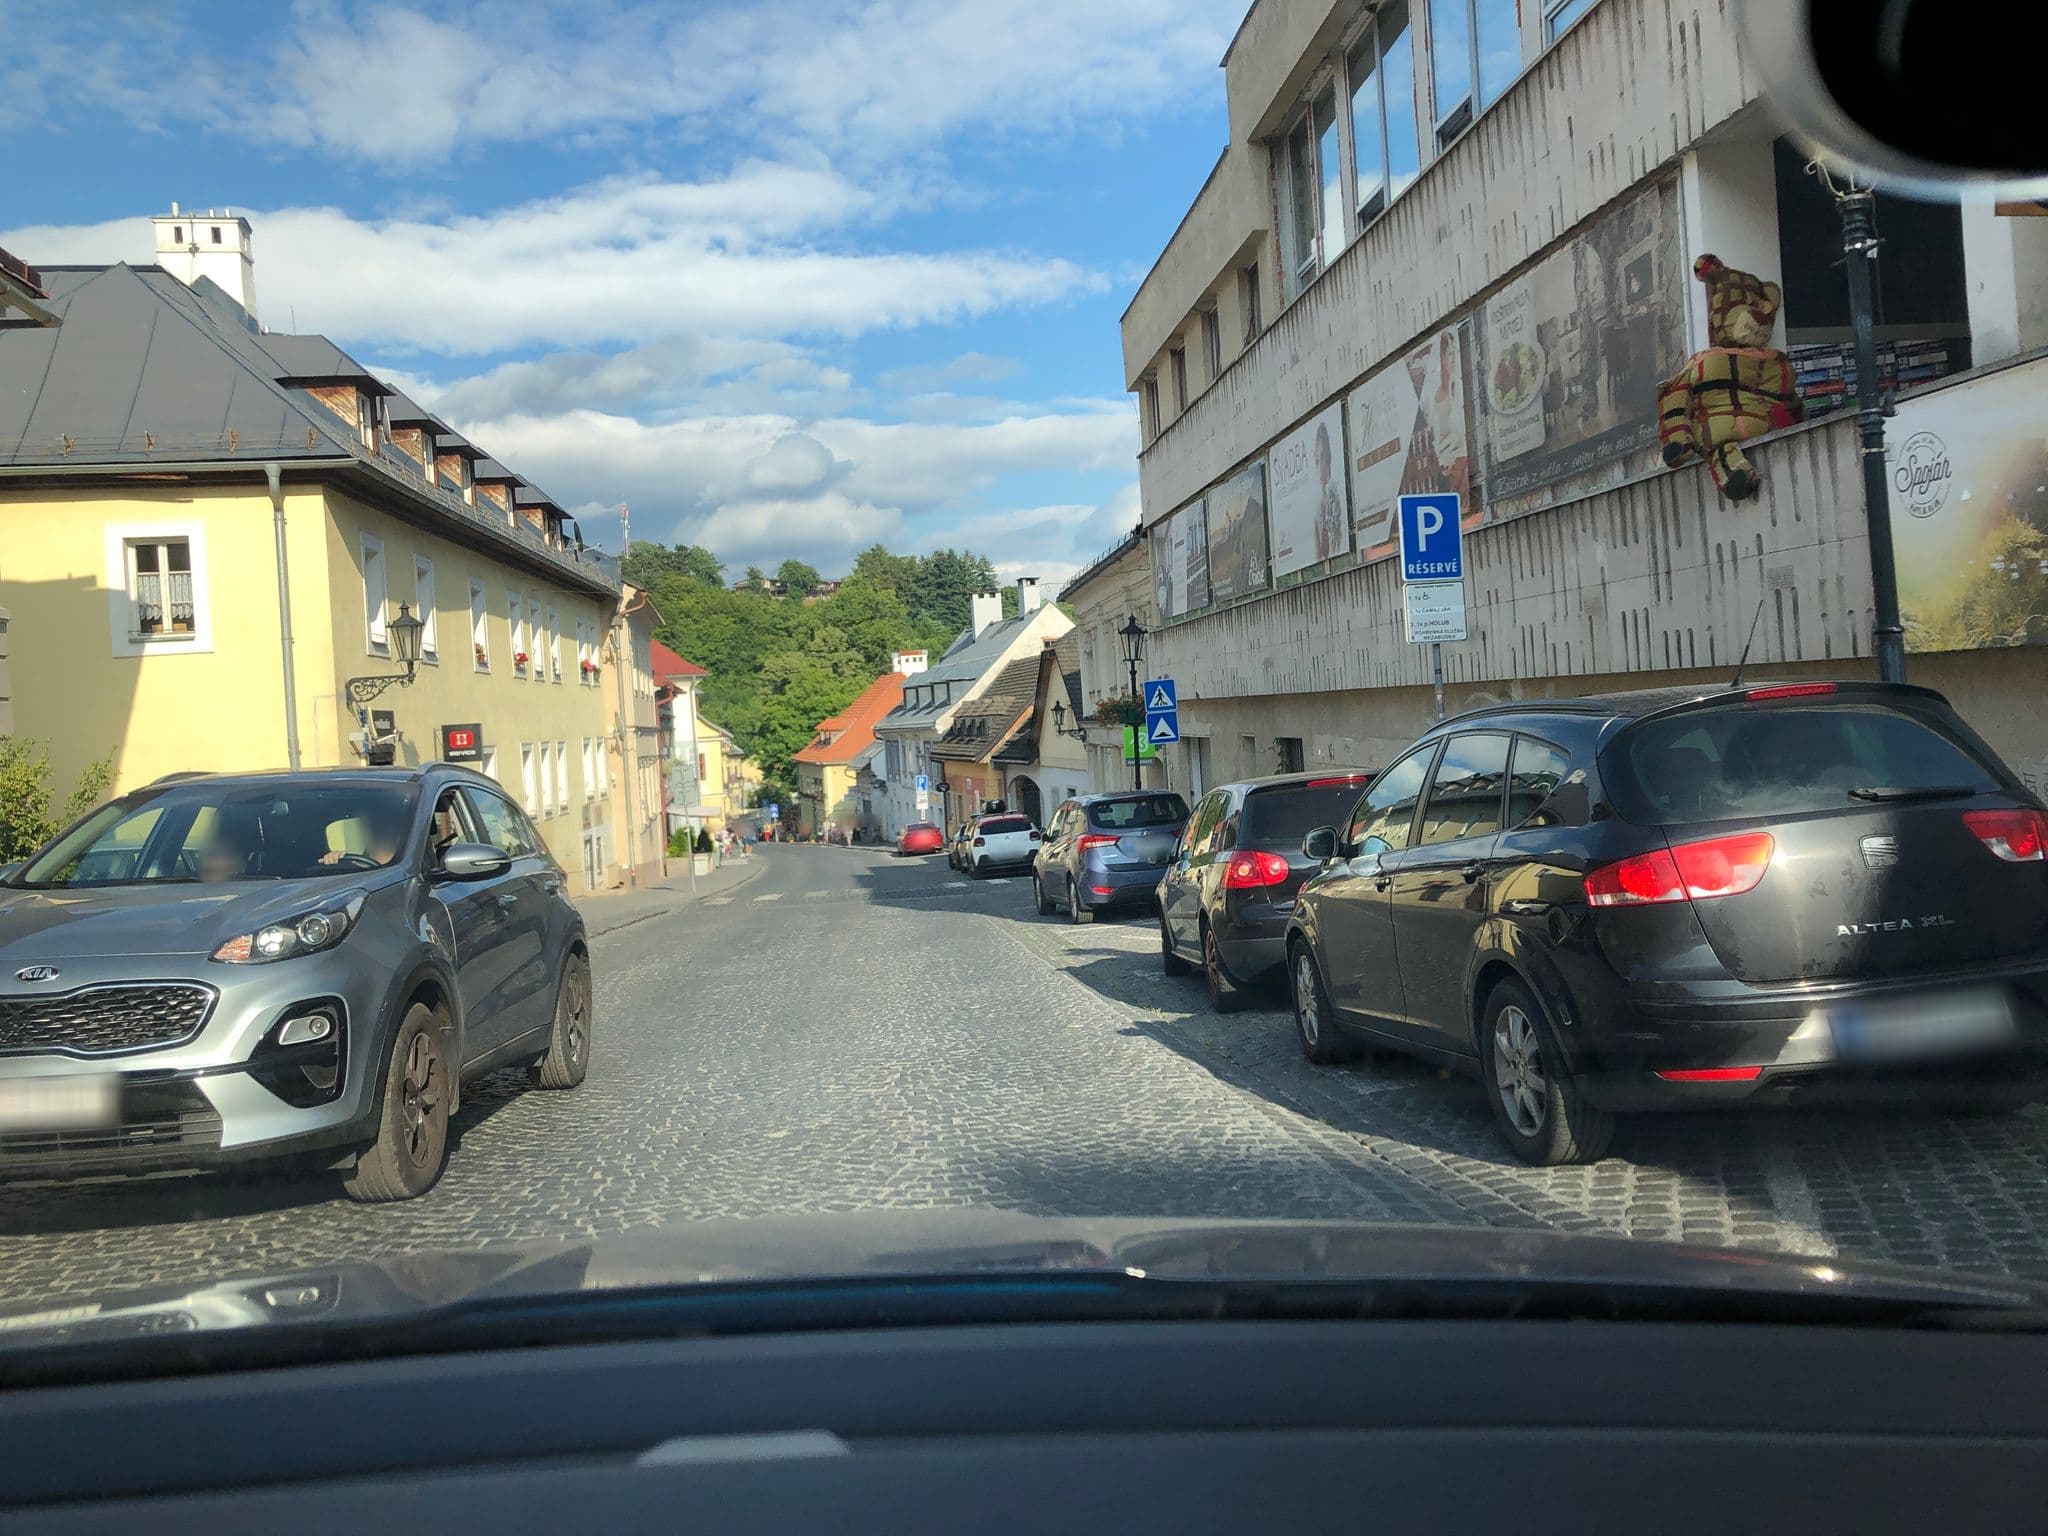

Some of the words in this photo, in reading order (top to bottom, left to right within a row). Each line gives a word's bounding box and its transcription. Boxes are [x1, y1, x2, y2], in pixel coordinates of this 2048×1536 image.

[1273, 440, 1308, 487] SVADBA
[1416, 505, 1444, 553] P
[1408, 557, 1458, 575] RÉSERVÉ
[1837, 919, 1914, 936] ALTEA
[1920, 915, 1956, 927] XL
[22, 968, 52, 979] KIA
